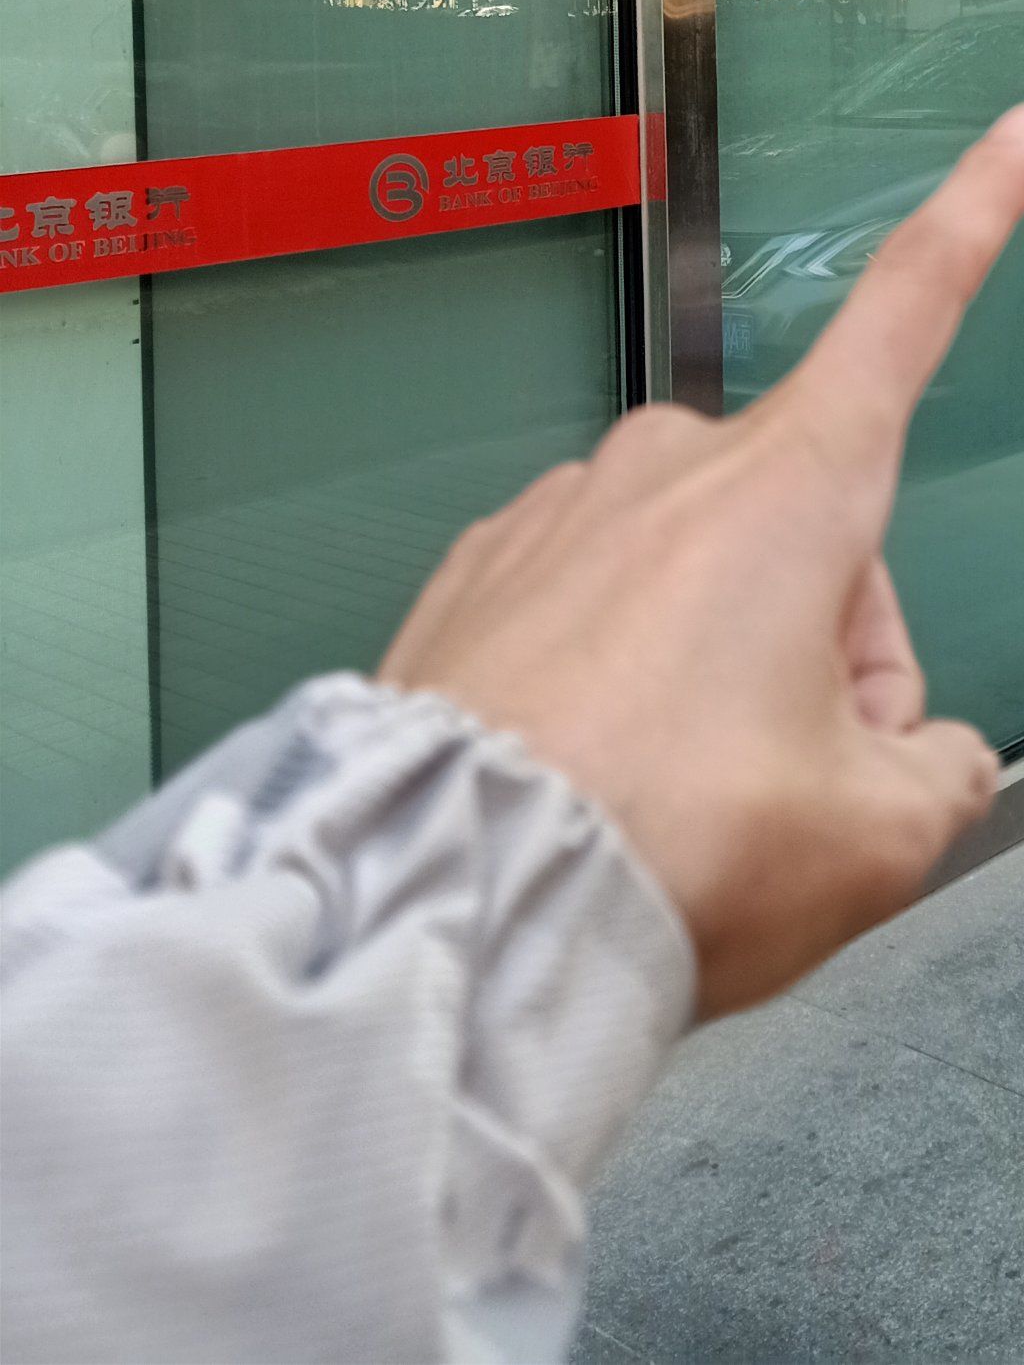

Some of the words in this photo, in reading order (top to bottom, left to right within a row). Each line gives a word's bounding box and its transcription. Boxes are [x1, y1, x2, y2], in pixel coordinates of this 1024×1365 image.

[443, 142, 594, 187] 北京银行
[439, 190, 493, 211] BANK
[498, 186, 523, 202] OF
[528, 176, 600, 200] BEIJING
[48, 240, 86, 263] OF
[93, 227, 198, 258] BEIJING
